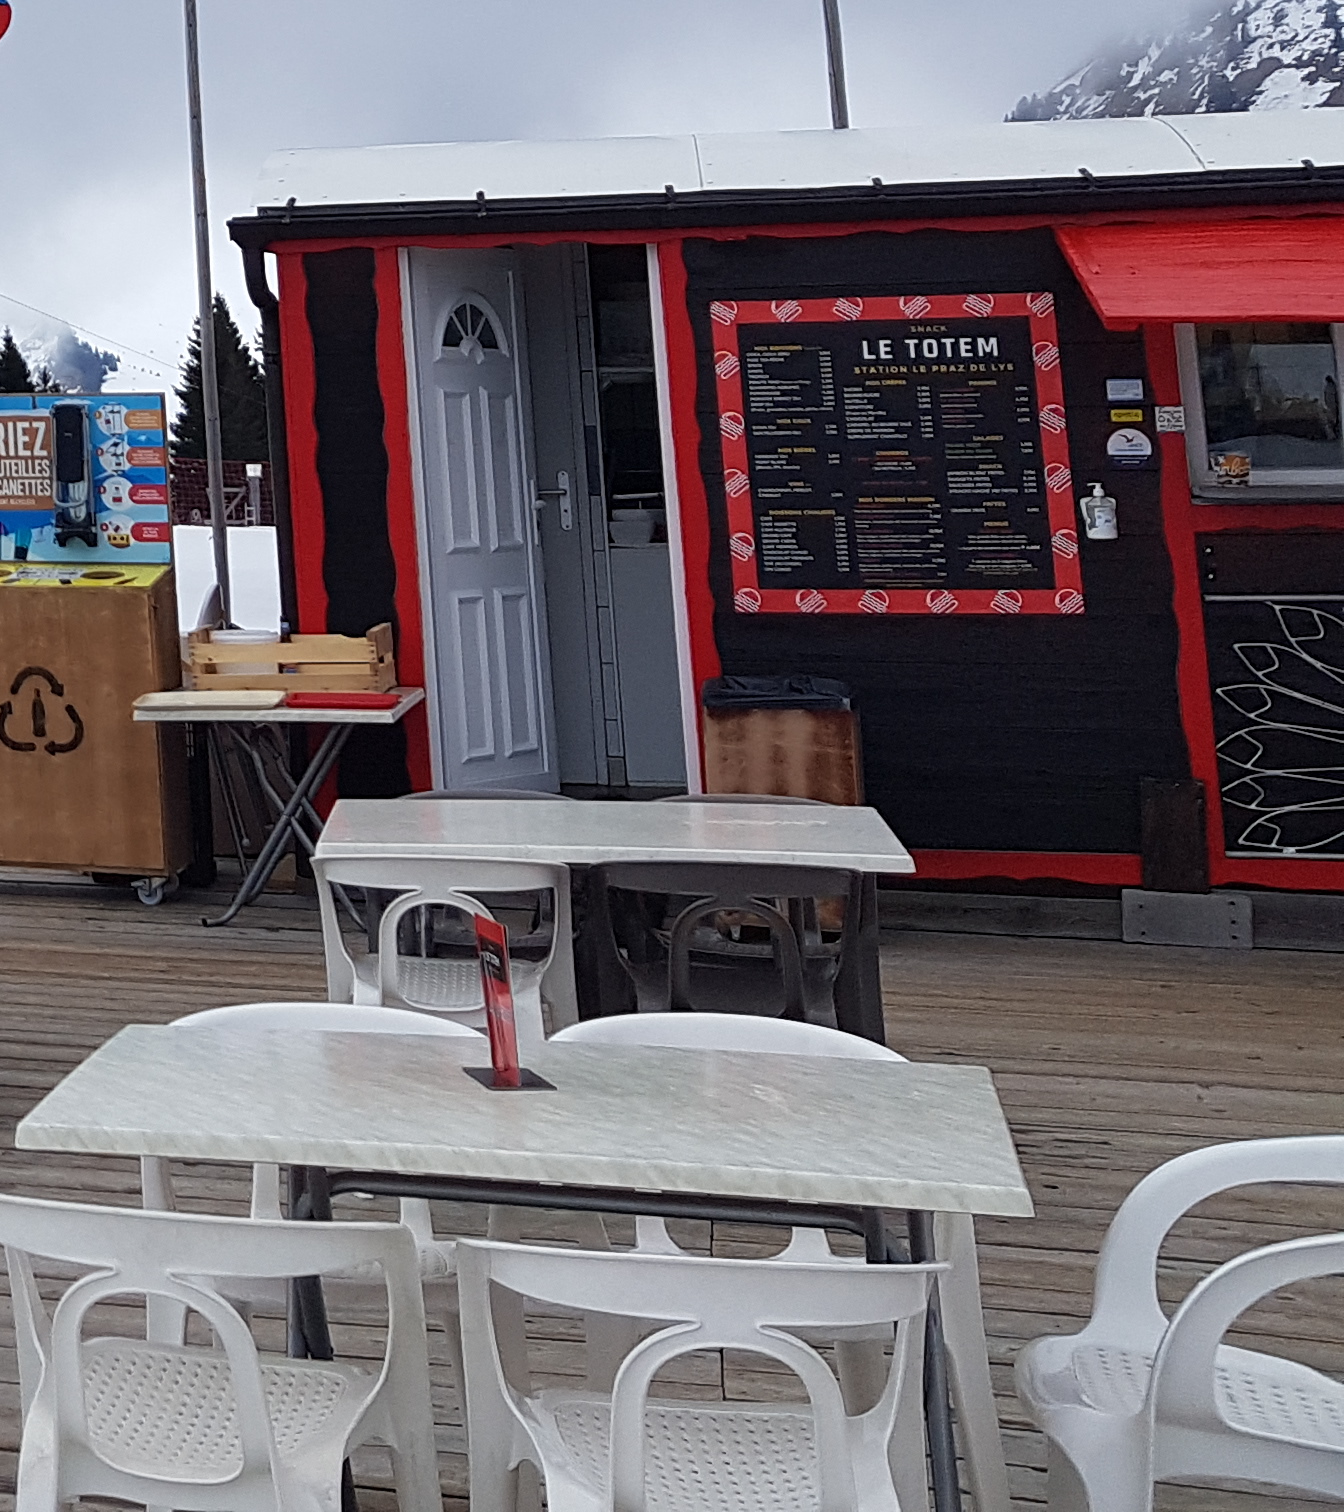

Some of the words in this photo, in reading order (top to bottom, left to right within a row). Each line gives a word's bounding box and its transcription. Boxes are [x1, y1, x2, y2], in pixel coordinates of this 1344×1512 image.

[910, 325, 948, 333] SNACK
[862, 339, 894, 360] LE
[904, 337, 999, 359] TOTEM
[854, 364, 908, 375] STATION
[913, 364, 927, 373] LE
[931, 363, 966, 373] PRAZ
[970, 363, 986, 372] DE
[991, 363, 1014, 372] LYS
